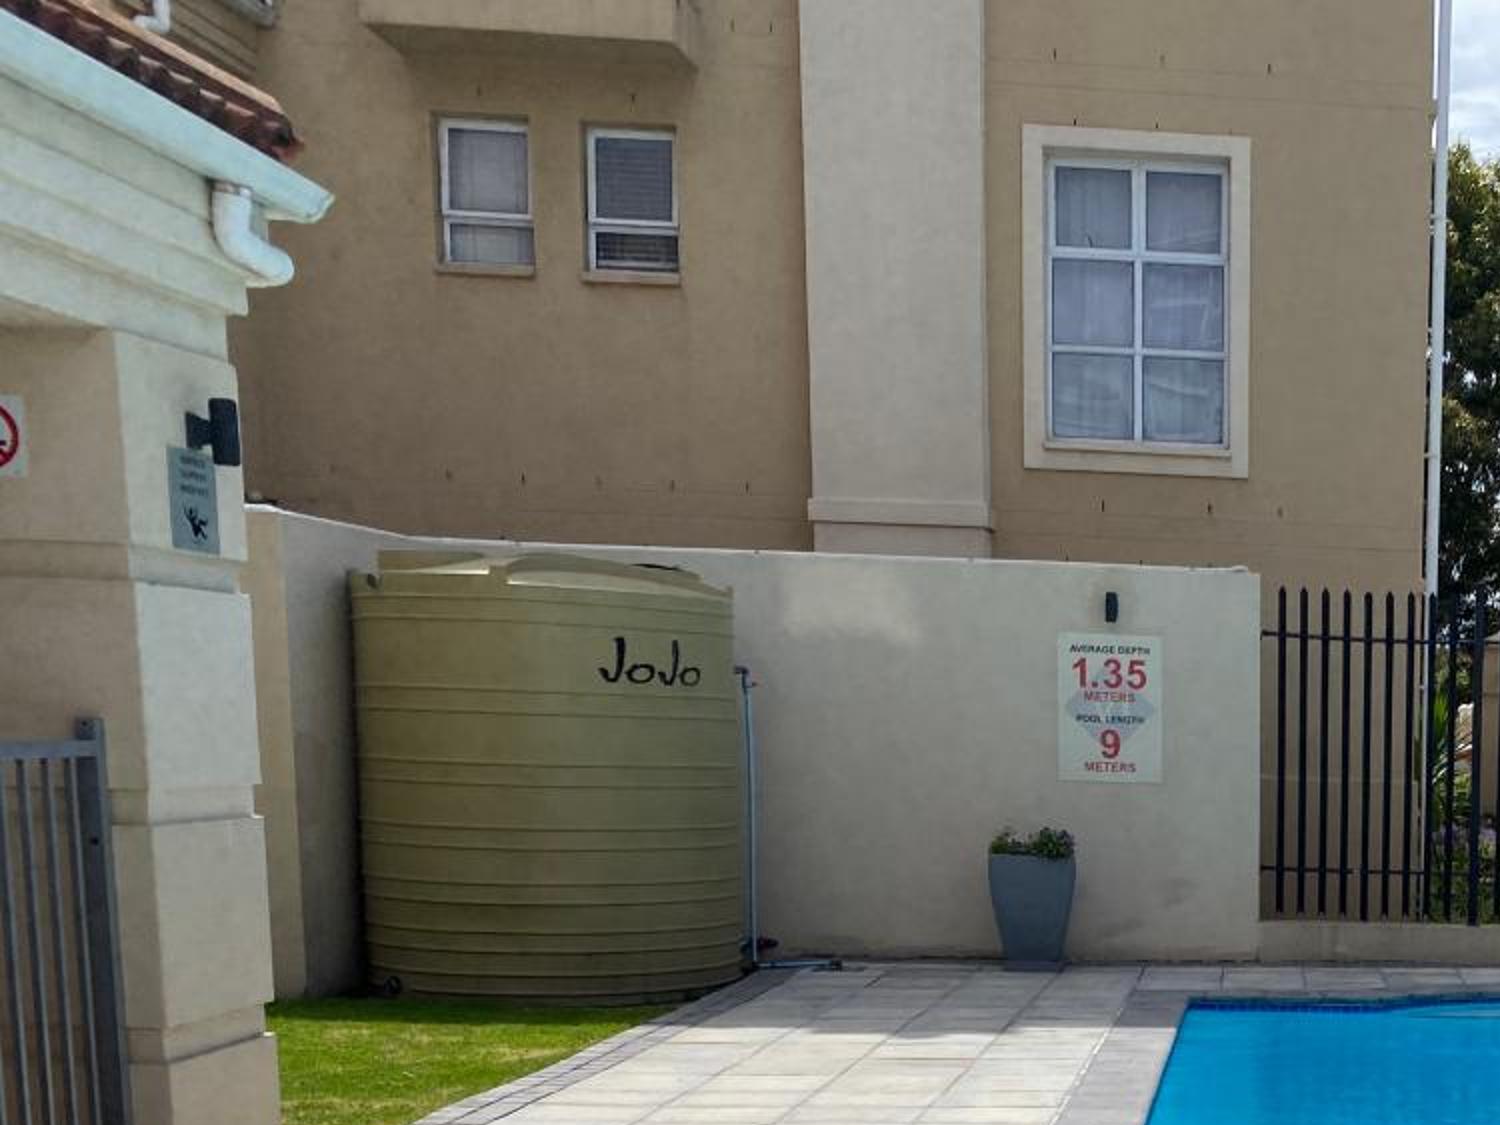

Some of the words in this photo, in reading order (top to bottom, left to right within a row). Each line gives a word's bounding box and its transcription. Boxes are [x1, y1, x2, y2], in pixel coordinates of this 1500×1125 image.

[1069, 644, 1115, 655] AVERAGE
[1117, 645, 1151, 656] DEPTH
[598, 636, 701, 687] JoJo
[1072, 657, 1148, 691] 1.35
[1084, 691, 1136, 704] METERS
[1075, 715, 1102, 724] POOL
[1105, 715, 1145, 725] LENGTH
[1100, 729, 1122, 759] 9
[1084, 761, 1137, 774] METERS
